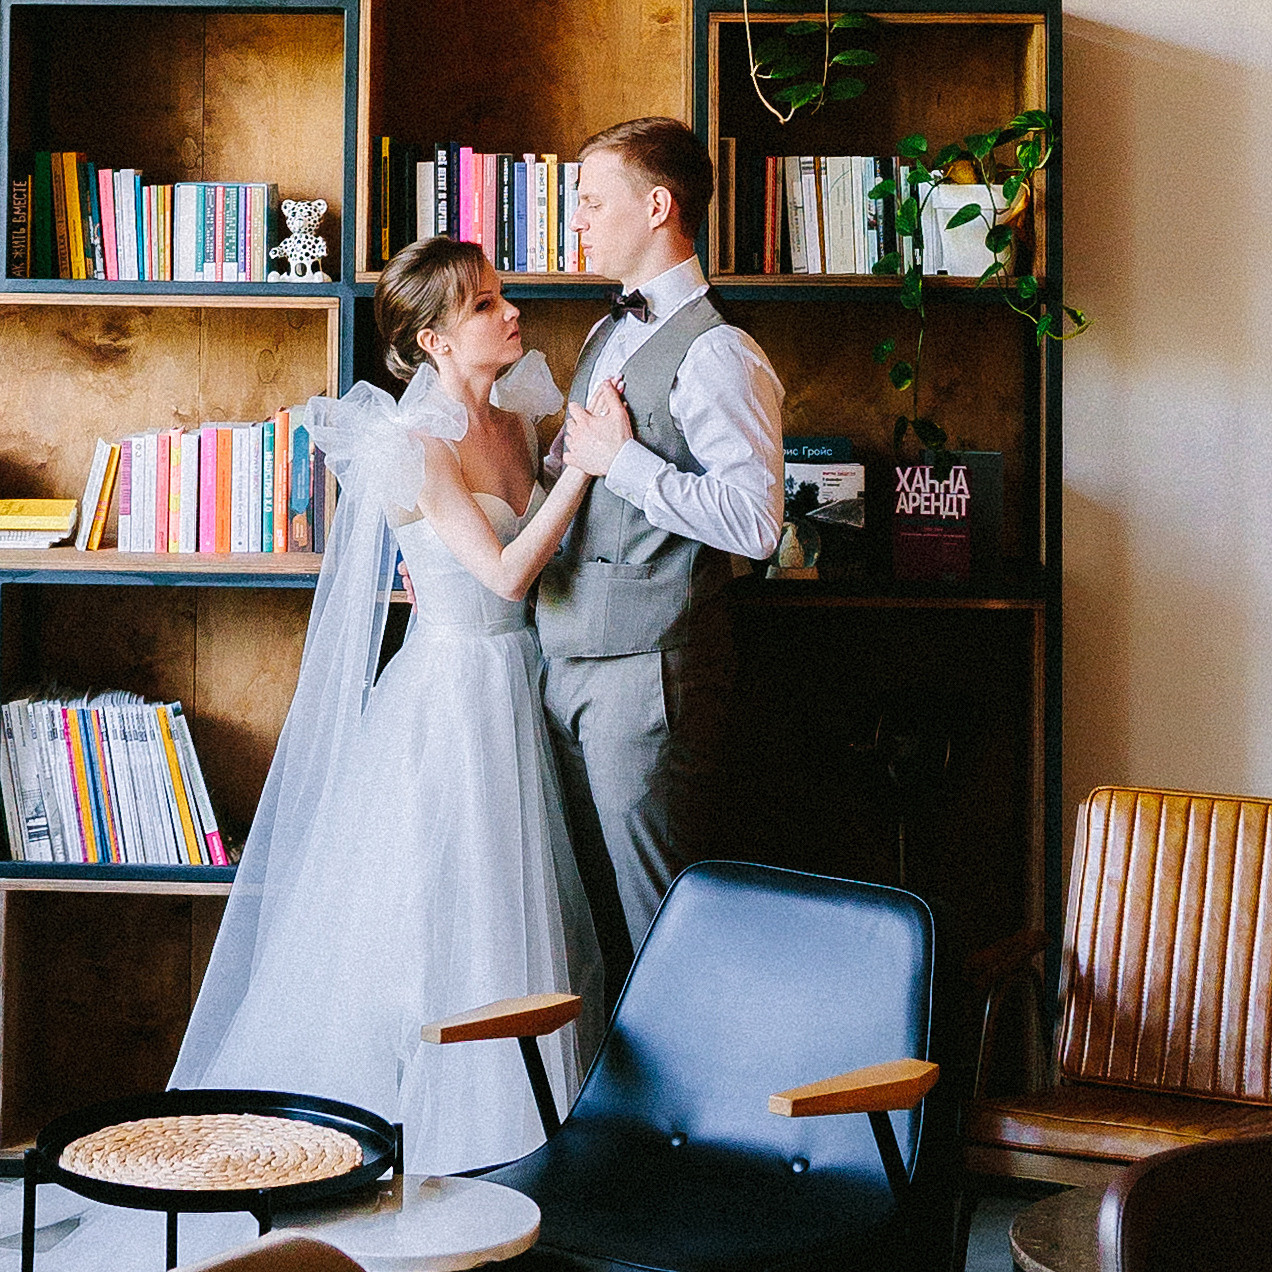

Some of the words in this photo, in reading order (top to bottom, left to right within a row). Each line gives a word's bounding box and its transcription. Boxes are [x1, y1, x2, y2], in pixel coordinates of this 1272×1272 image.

[12, 180, 27, 224] ВМЕСТЕ
[12, 227, 26, 259] ЖИТЬ
[12, 262, 26, 278] АК
[802, 445, 833, 459] Гройс
[895, 491, 971, 520] АРЕНДТ
